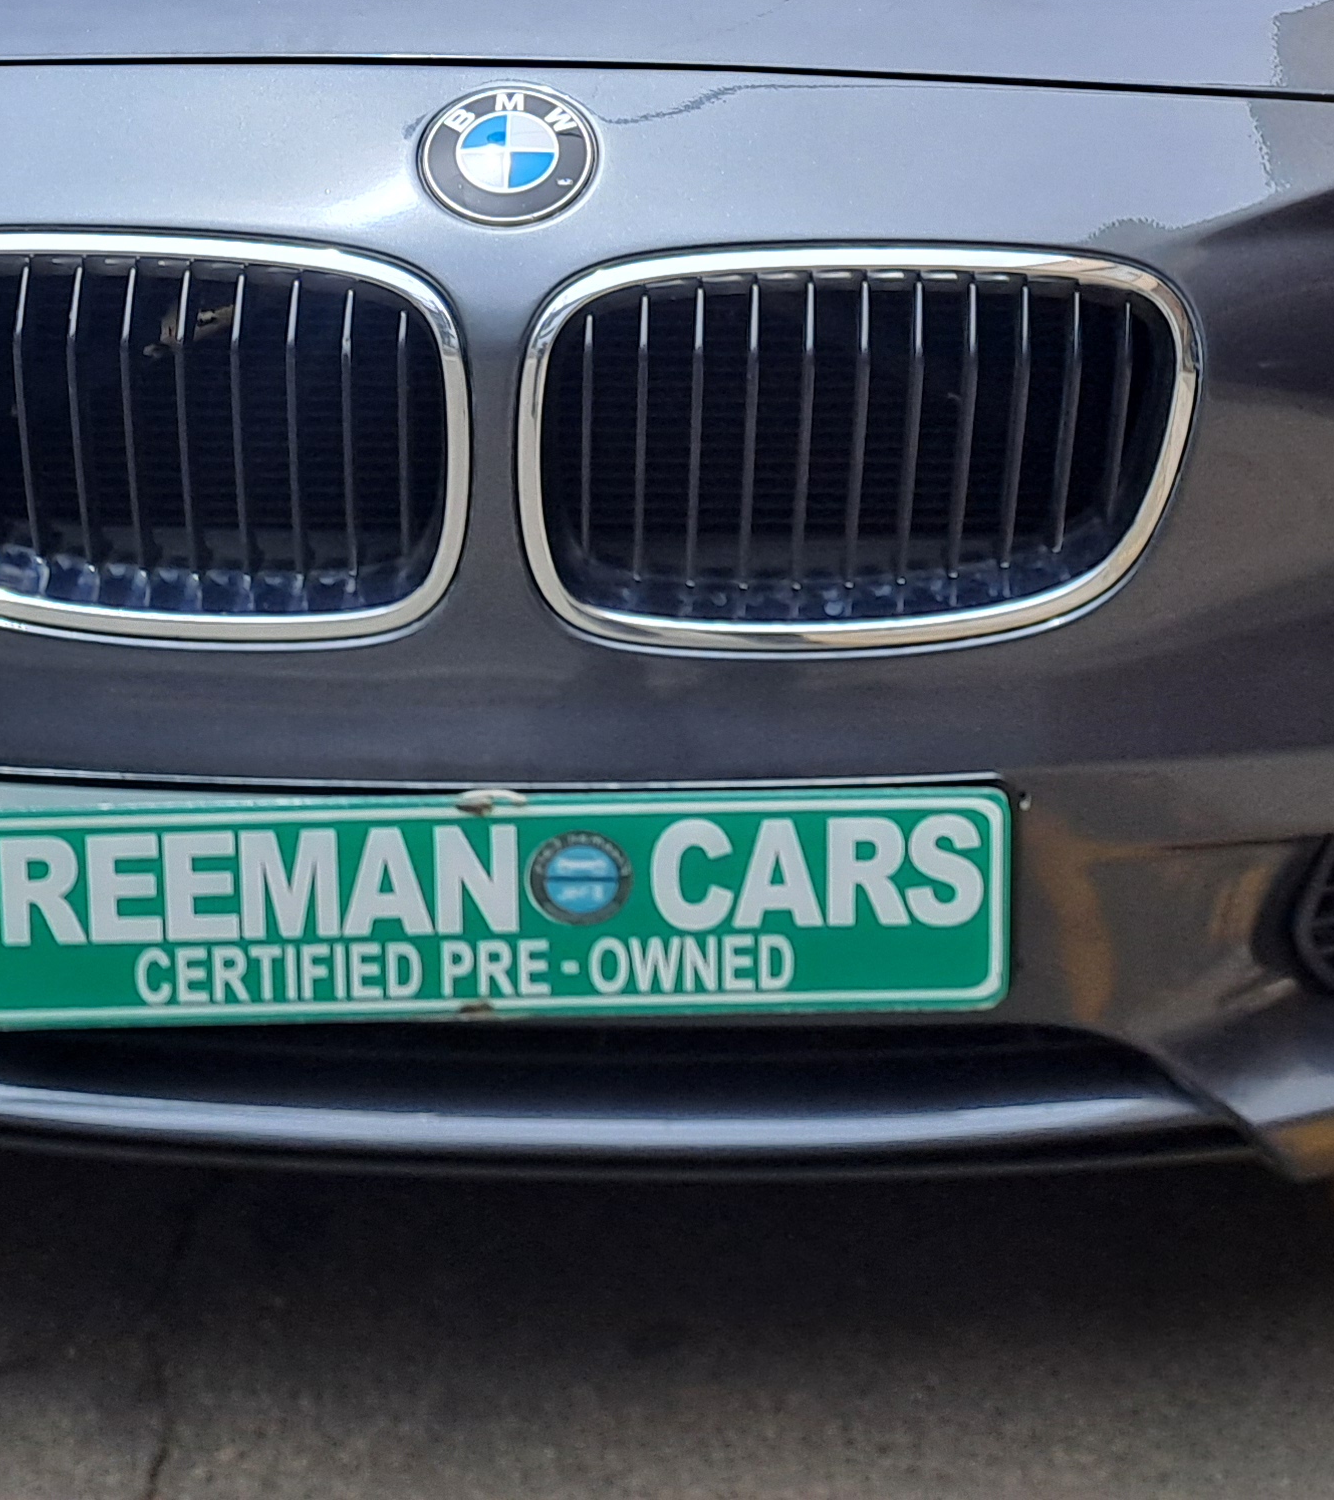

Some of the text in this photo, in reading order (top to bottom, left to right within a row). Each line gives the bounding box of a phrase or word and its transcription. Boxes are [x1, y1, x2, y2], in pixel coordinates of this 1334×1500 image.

[443, 92, 578, 133] BMW
[649, 813, 986, 932] CARS
[134, 941, 424, 1006] CERTIFIED
